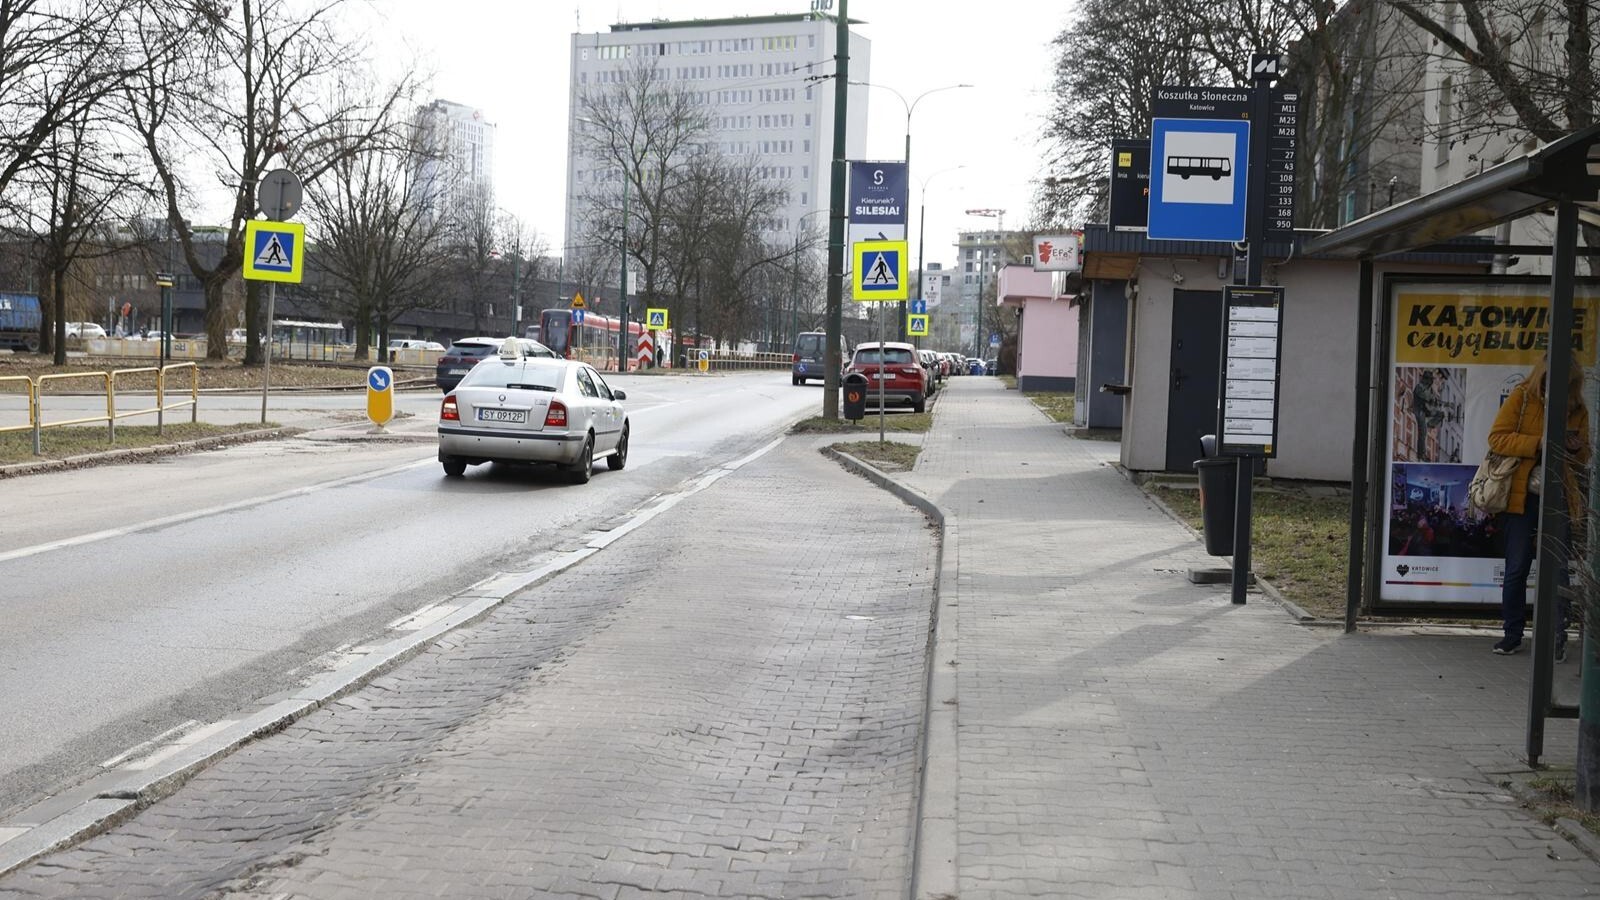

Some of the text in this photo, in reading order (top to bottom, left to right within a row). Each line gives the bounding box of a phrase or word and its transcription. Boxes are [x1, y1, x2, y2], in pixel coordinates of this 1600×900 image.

[1158, 90, 1248, 102] Koszutka Słoneczna
[1279, 116, 1296, 124] M25
[1290, 140, 1294, 148] 5
[855, 206, 900, 216] SILESIA!
[1408, 304, 1587, 330] KATOWIE
[1483, 330, 1584, 351] BLUEA
[484, 410, 522, 420] SY 0912P
